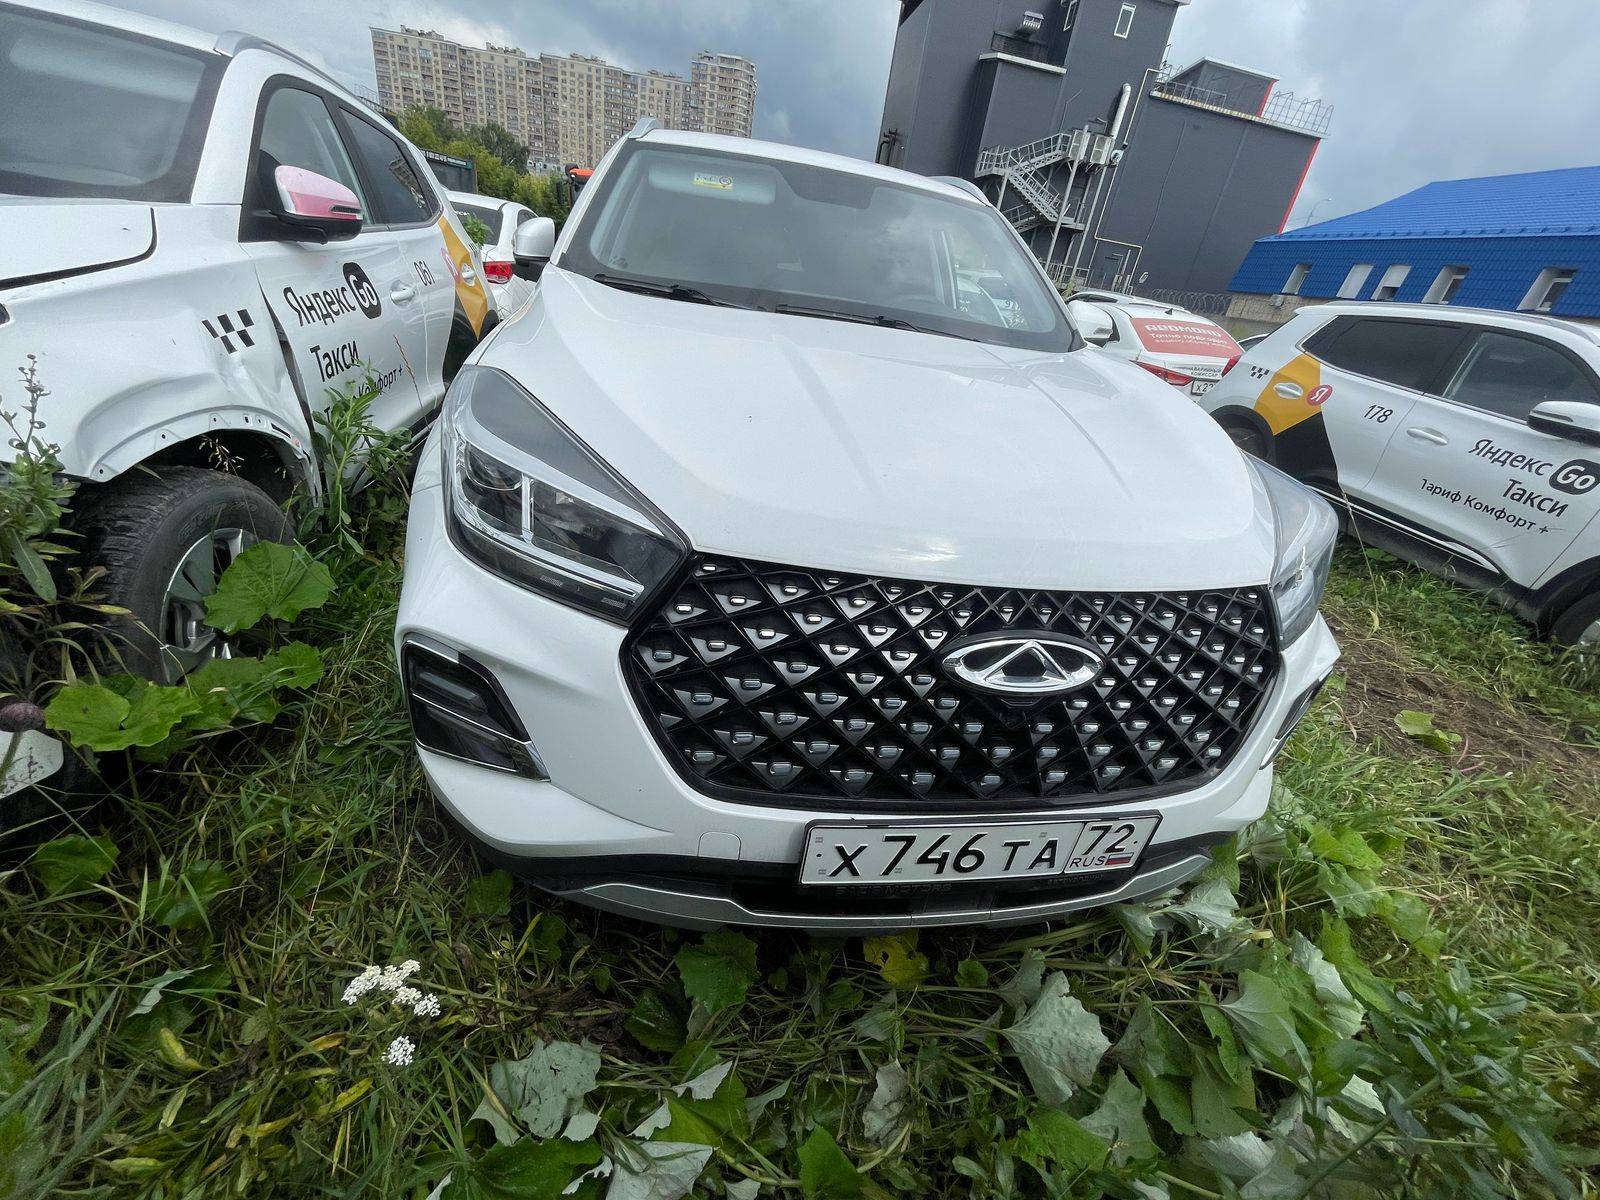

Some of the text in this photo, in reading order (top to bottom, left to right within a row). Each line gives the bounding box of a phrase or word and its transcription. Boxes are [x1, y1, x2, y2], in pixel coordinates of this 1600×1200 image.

[414, 261, 436, 287] 061
[283, 274, 379, 326] Яндекс Go
[310, 340, 359, 383] Такси
[1311, 388, 1328, 403] Я
[1363, 403, 1394, 424] 178
[1468, 438, 1596, 491] Яндекс Go
[1420, 478, 1462, 504] Тариф
[1465, 494, 1537, 532] Комфорт
[1503, 479, 1570, 517] Такси
[1081, 823, 1135, 855] 72
[1069, 855, 1105, 869] RUS
